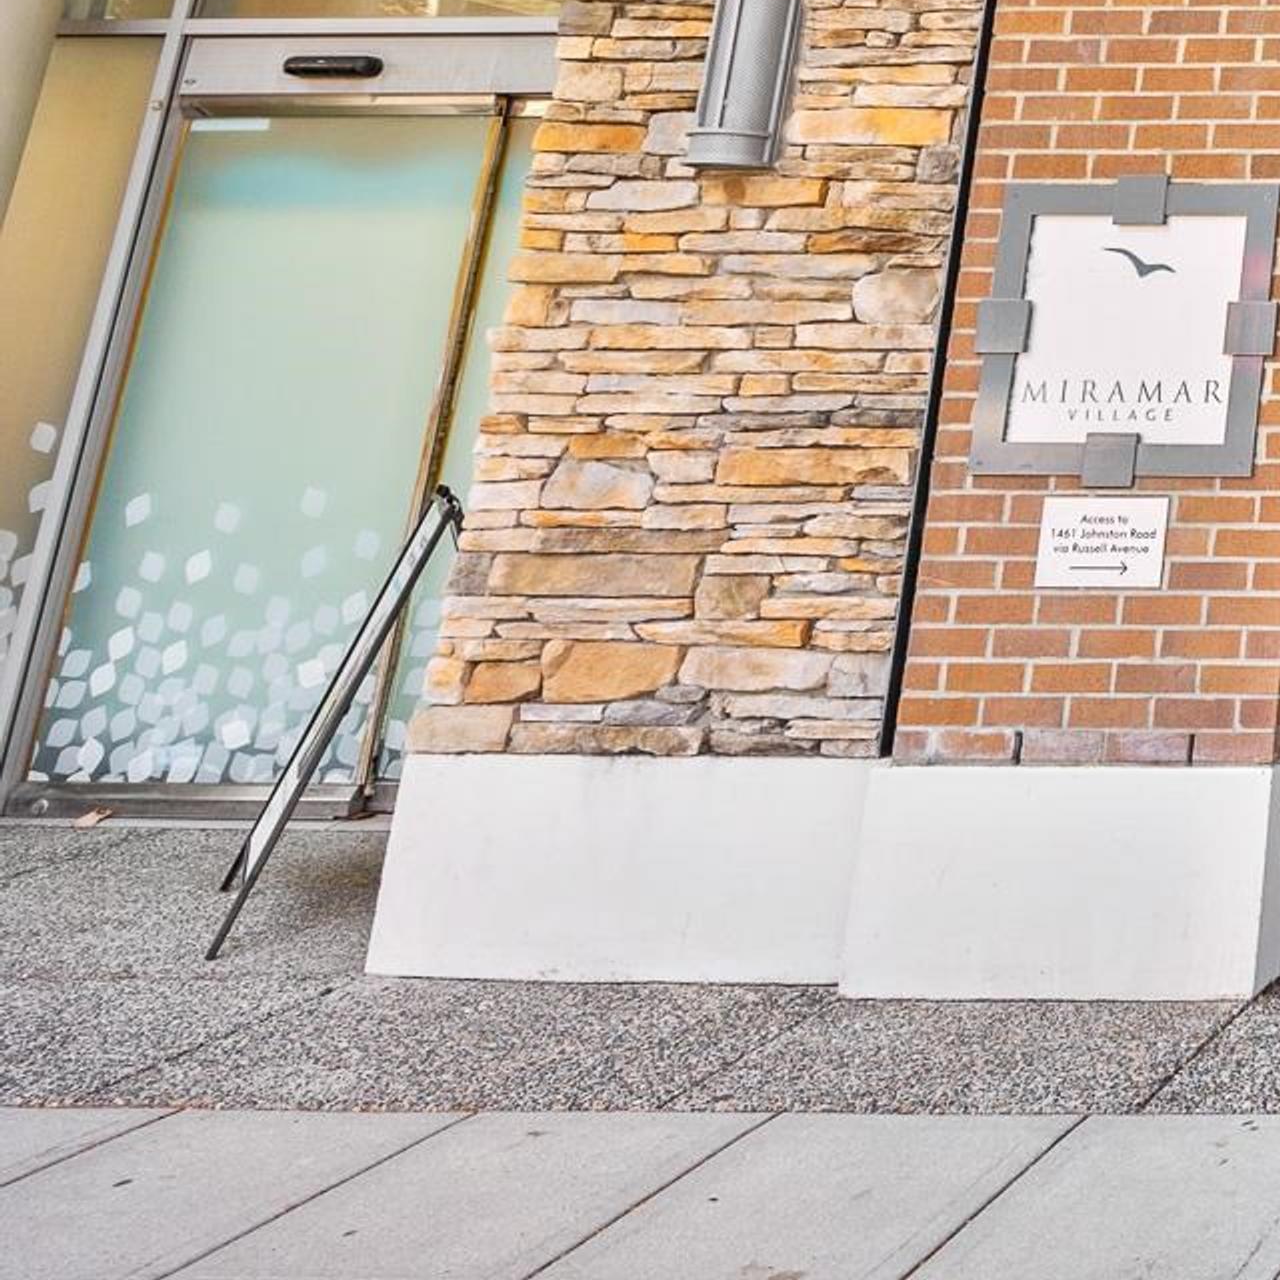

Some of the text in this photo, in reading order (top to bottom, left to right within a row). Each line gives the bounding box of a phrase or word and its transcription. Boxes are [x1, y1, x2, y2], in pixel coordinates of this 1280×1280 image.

[1021, 378, 1223, 404] MIRAMAR
[1067, 407, 1174, 422] VILLAGE
[1080, 514, 1129, 525] Access to
[1080, 528, 1127, 539] Johnston
[1130, 528, 1157, 539] Road
[1053, 542, 1150, 554] via Russell Avenue
